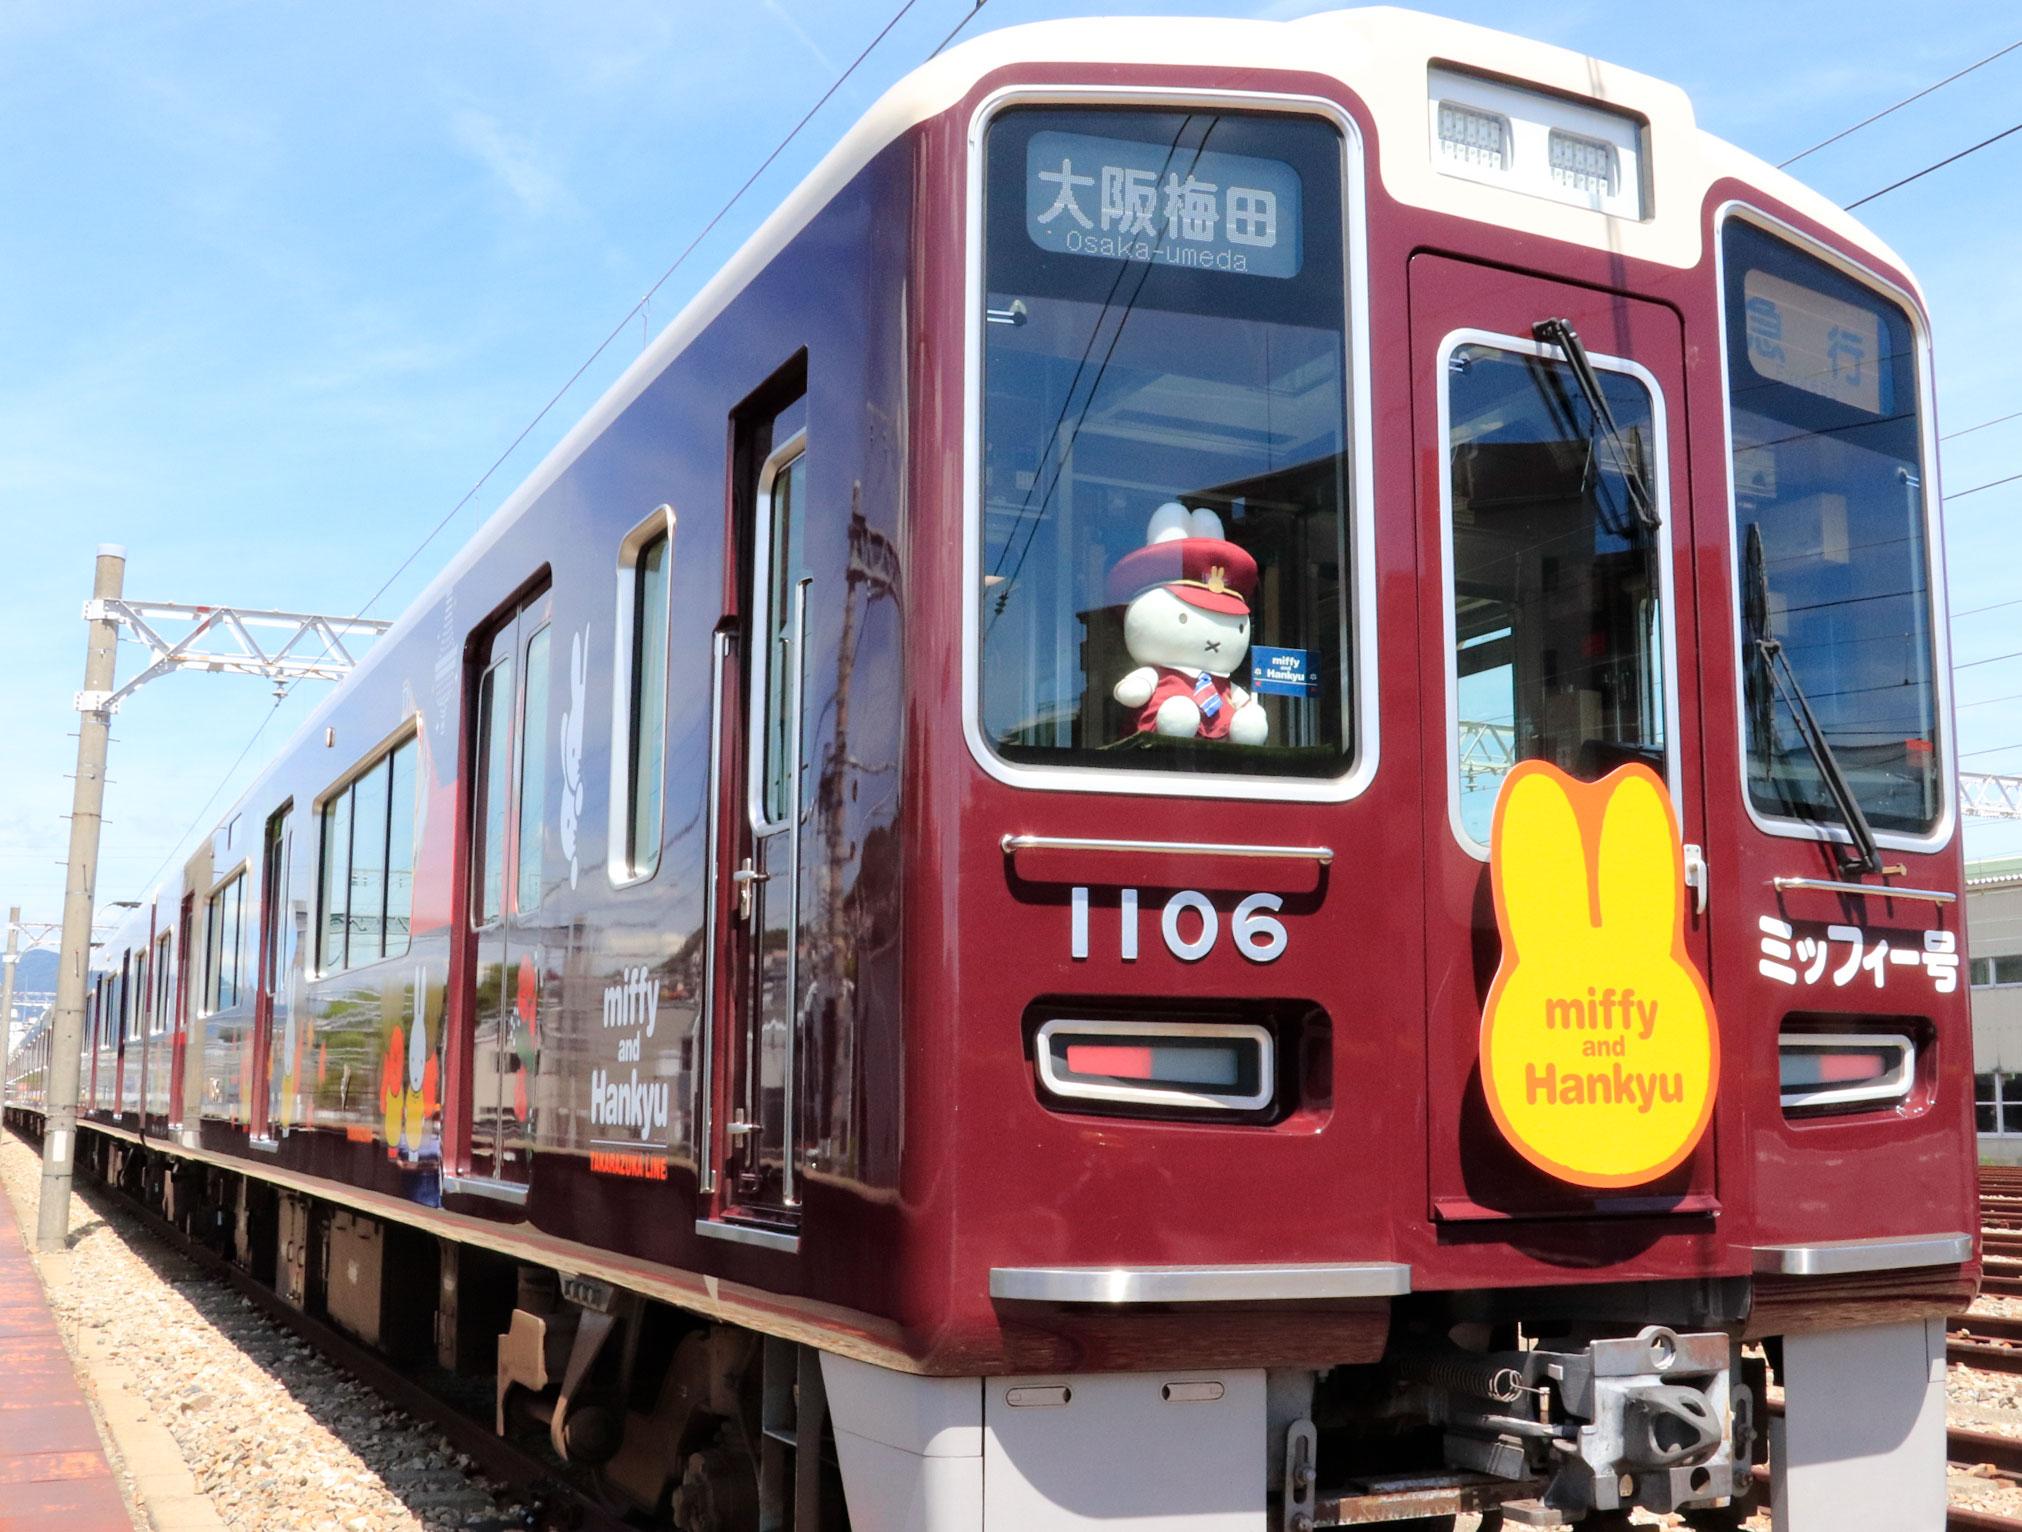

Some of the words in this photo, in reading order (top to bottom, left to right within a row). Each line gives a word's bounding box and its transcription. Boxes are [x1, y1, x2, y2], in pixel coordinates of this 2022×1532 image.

[1037, 158, 1278, 248] 大阪梅田
[1065, 230, 1249, 273] Osaka-umeda
[1266, 668, 1306, 682] Hankyu
[1272, 655, 1300, 668] miffy
[1071, 886, 1289, 962] 1106
[1758, 914, 1960, 994] ミッフィー号
[603, 965, 660, 1038] miffy
[1544, 986, 1659, 1040] miffy
[617, 1030, 642, 1063] and
[1581, 1034, 1626, 1057] and
[591, 1067, 669, 1141] Hankyu
[1524, 1061, 1684, 1114] Hankyu
[645, 1152, 669, 1181] LINE
